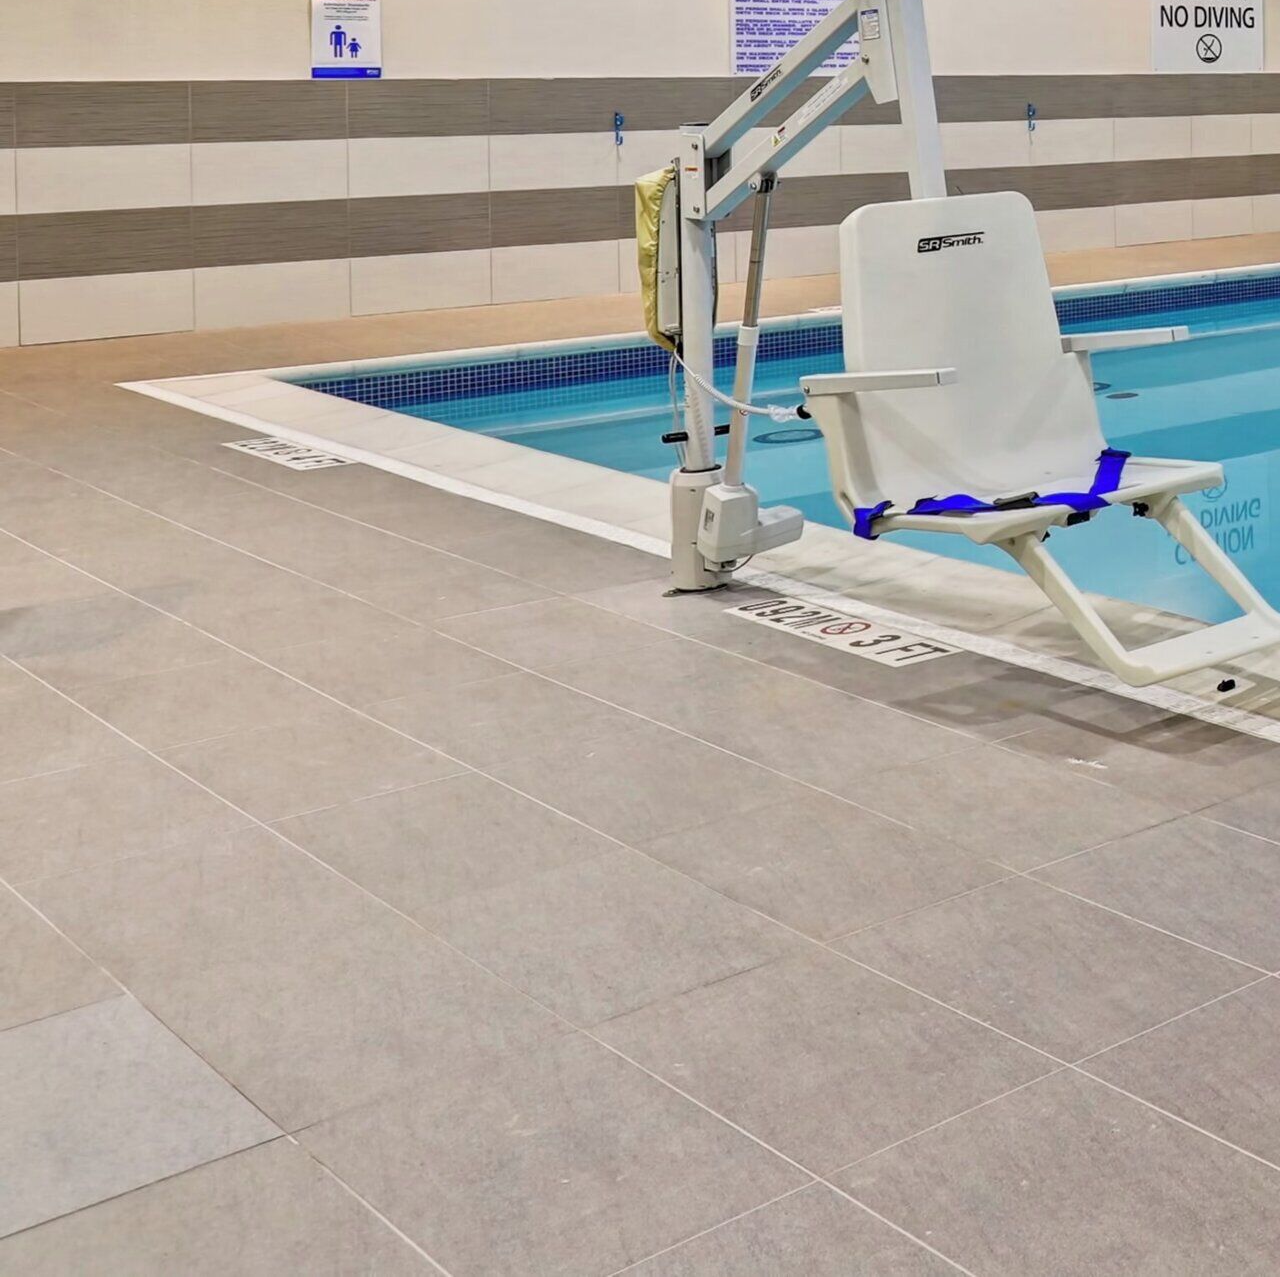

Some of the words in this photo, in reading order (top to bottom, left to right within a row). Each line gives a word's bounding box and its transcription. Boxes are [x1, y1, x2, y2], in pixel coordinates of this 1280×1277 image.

[1161, 5, 1188, 27] NO
[1194, 6, 1255, 28] DIVING
[918, 239, 941, 252] SR
[942, 235, 981, 248] Smith
[849, 634, 901, 647] 3
[875, 641, 951, 662] FT
